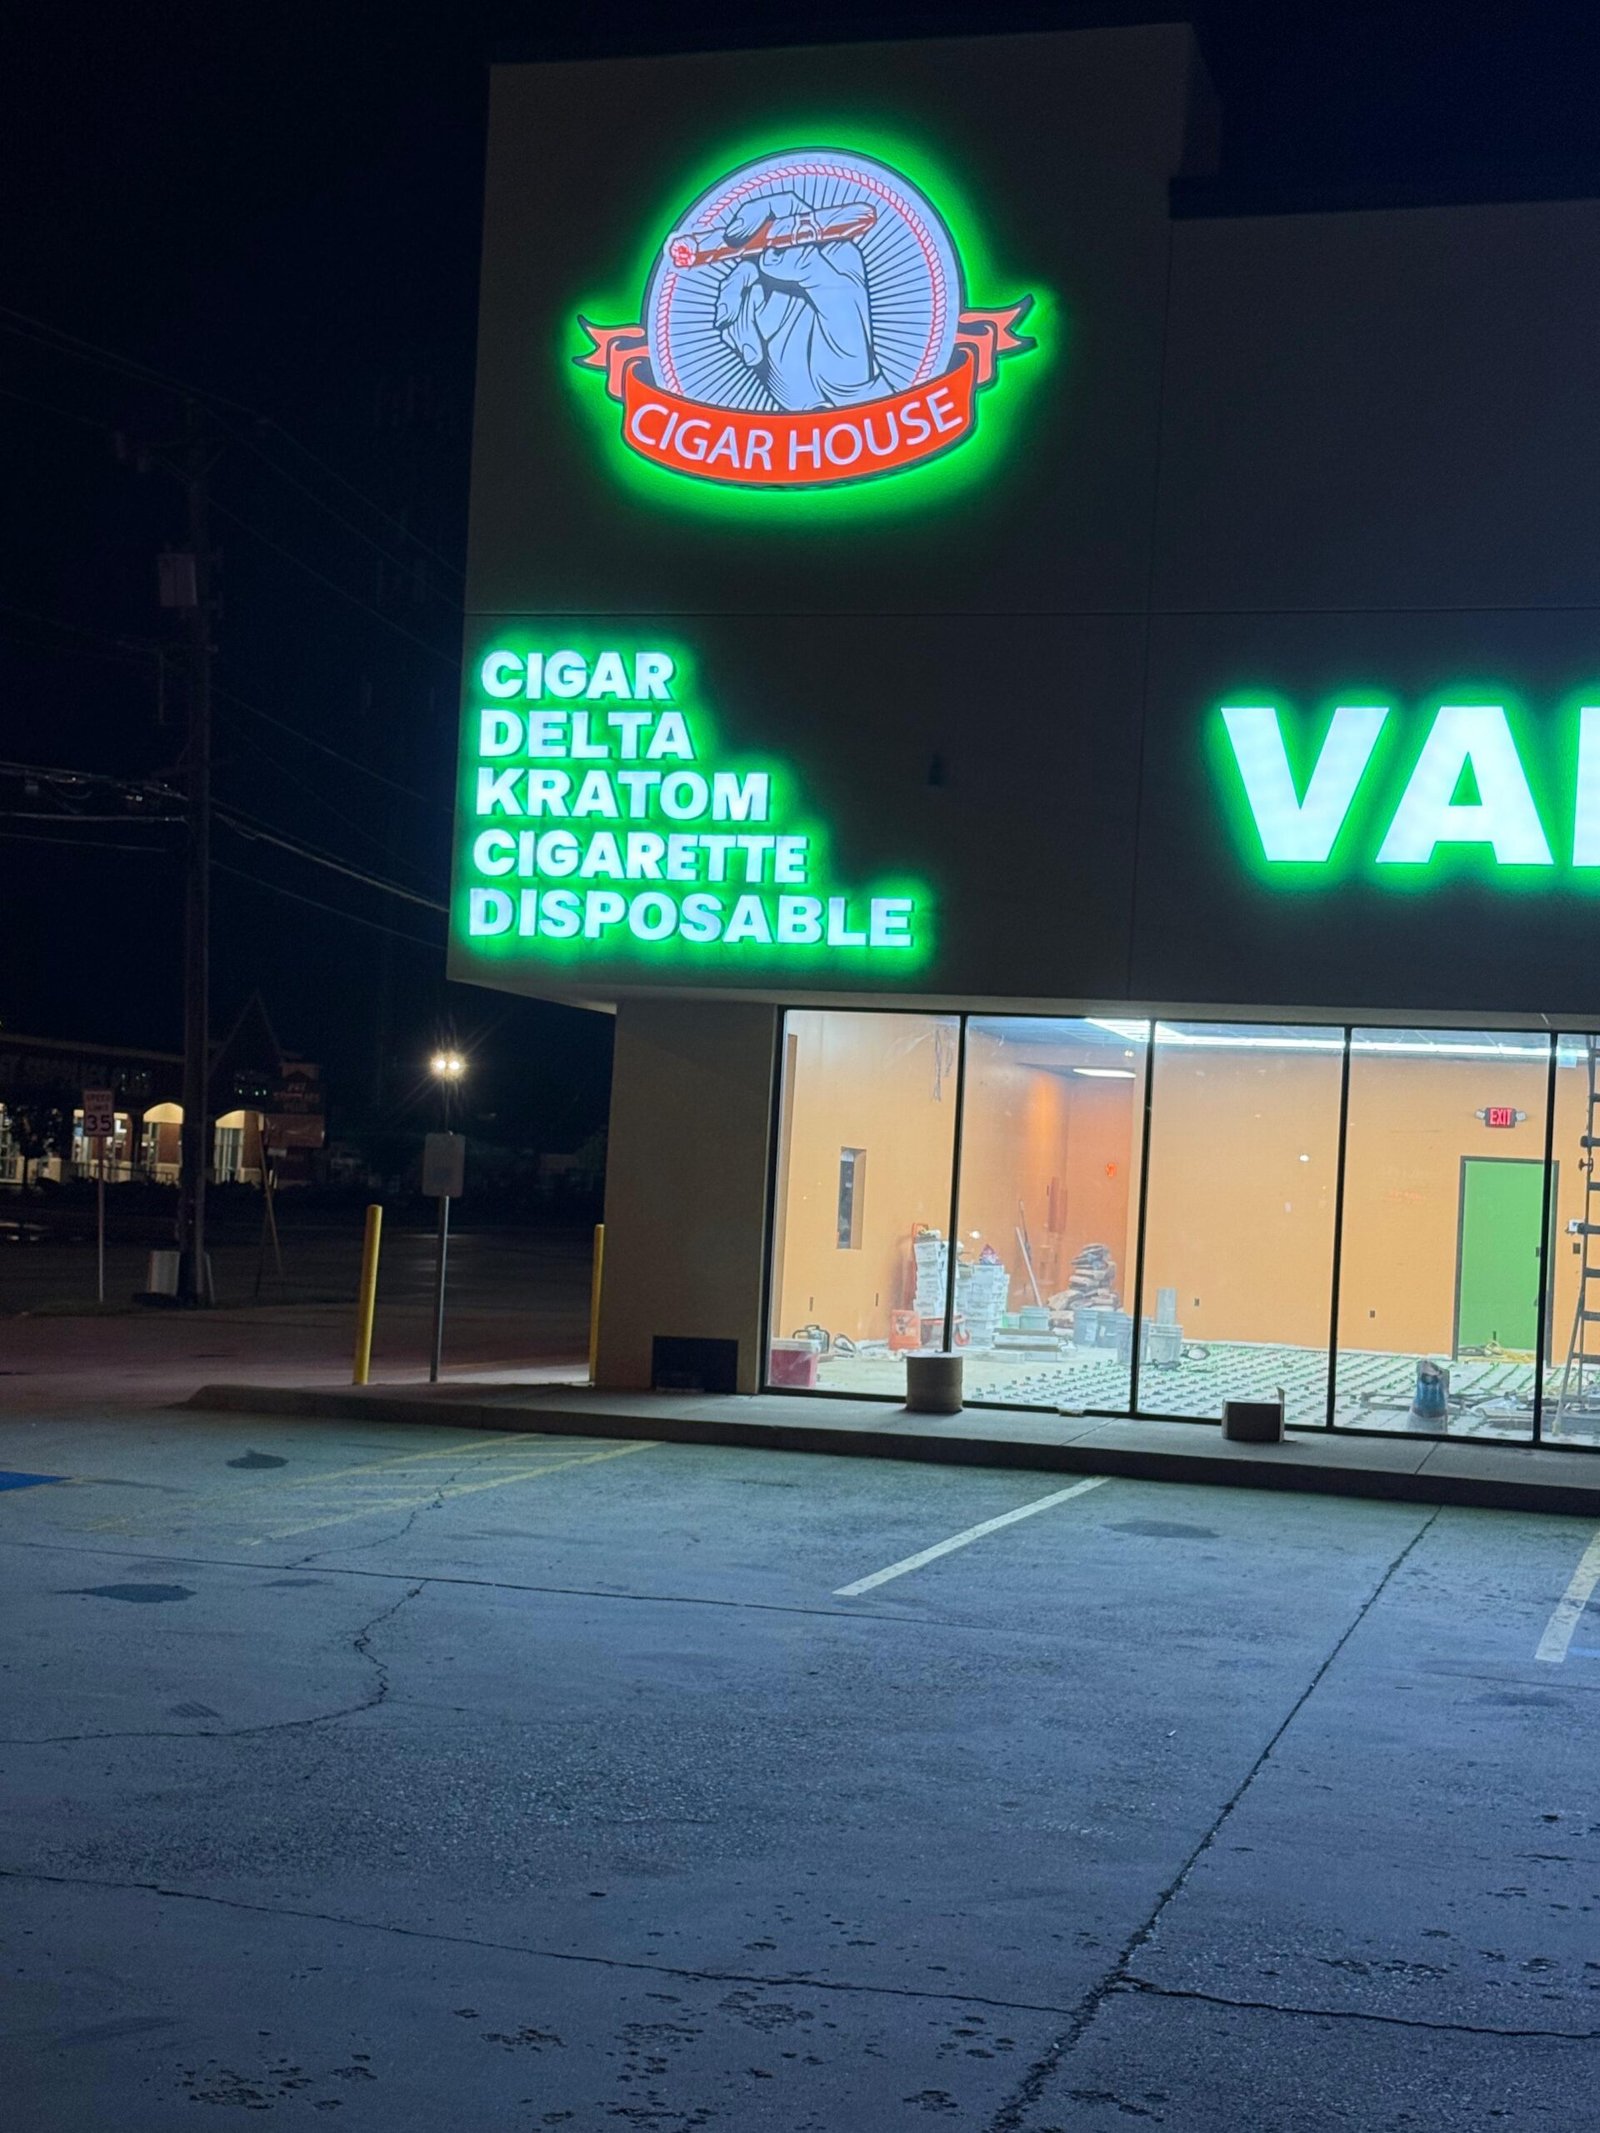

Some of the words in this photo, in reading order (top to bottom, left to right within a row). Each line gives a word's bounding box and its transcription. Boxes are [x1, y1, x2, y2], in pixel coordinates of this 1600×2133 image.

[630, 402, 774, 472] CIGAR
[787, 387, 963, 472] HOUSE
[480, 648, 676, 700] CIGAR
[478, 708, 695, 760] DELTA
[475, 766, 770, 822] KRATOM
[1220, 705, 1600, 868] VA
[472, 828, 809, 884] CIGARETTE
[468, 887, 915, 948] DISPOSABLE
[87, 1114, 112, 1132] 35
[1489, 1108, 1512, 1126] EXIT
